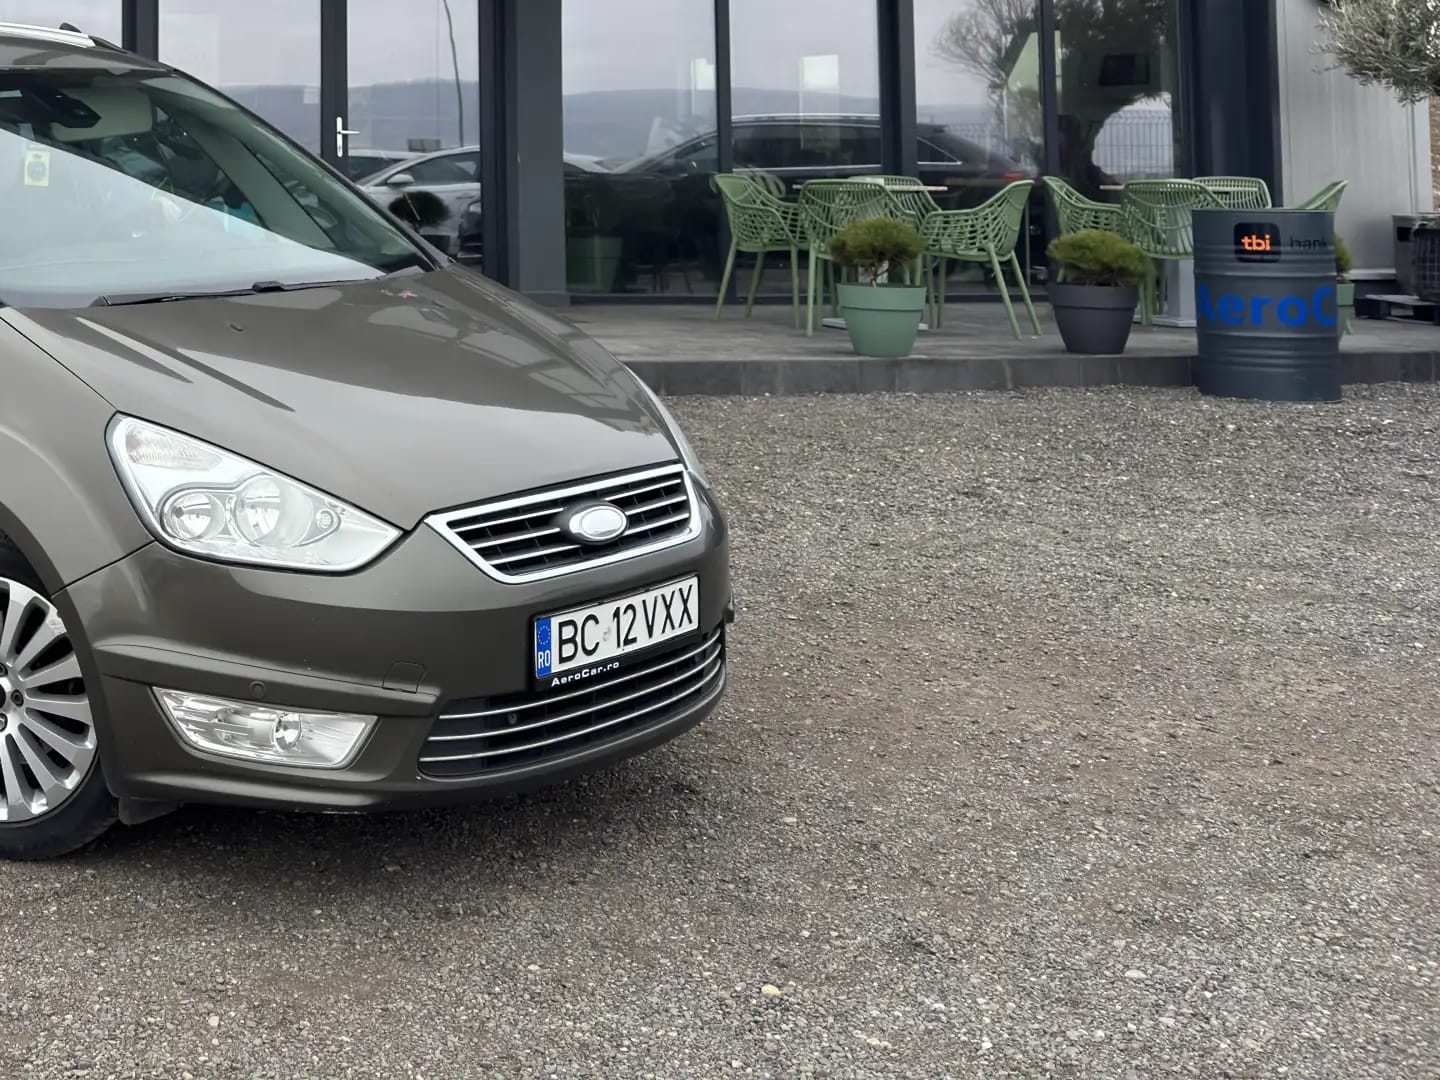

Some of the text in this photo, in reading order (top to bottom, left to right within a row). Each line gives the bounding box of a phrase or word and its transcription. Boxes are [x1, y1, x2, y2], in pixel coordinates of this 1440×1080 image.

[1240, 233, 1272, 252] tbi
[558, 613, 600, 665] BC
[537, 650, 551, 670] RO
[551, 661, 620, 687] AeroCar.ro
